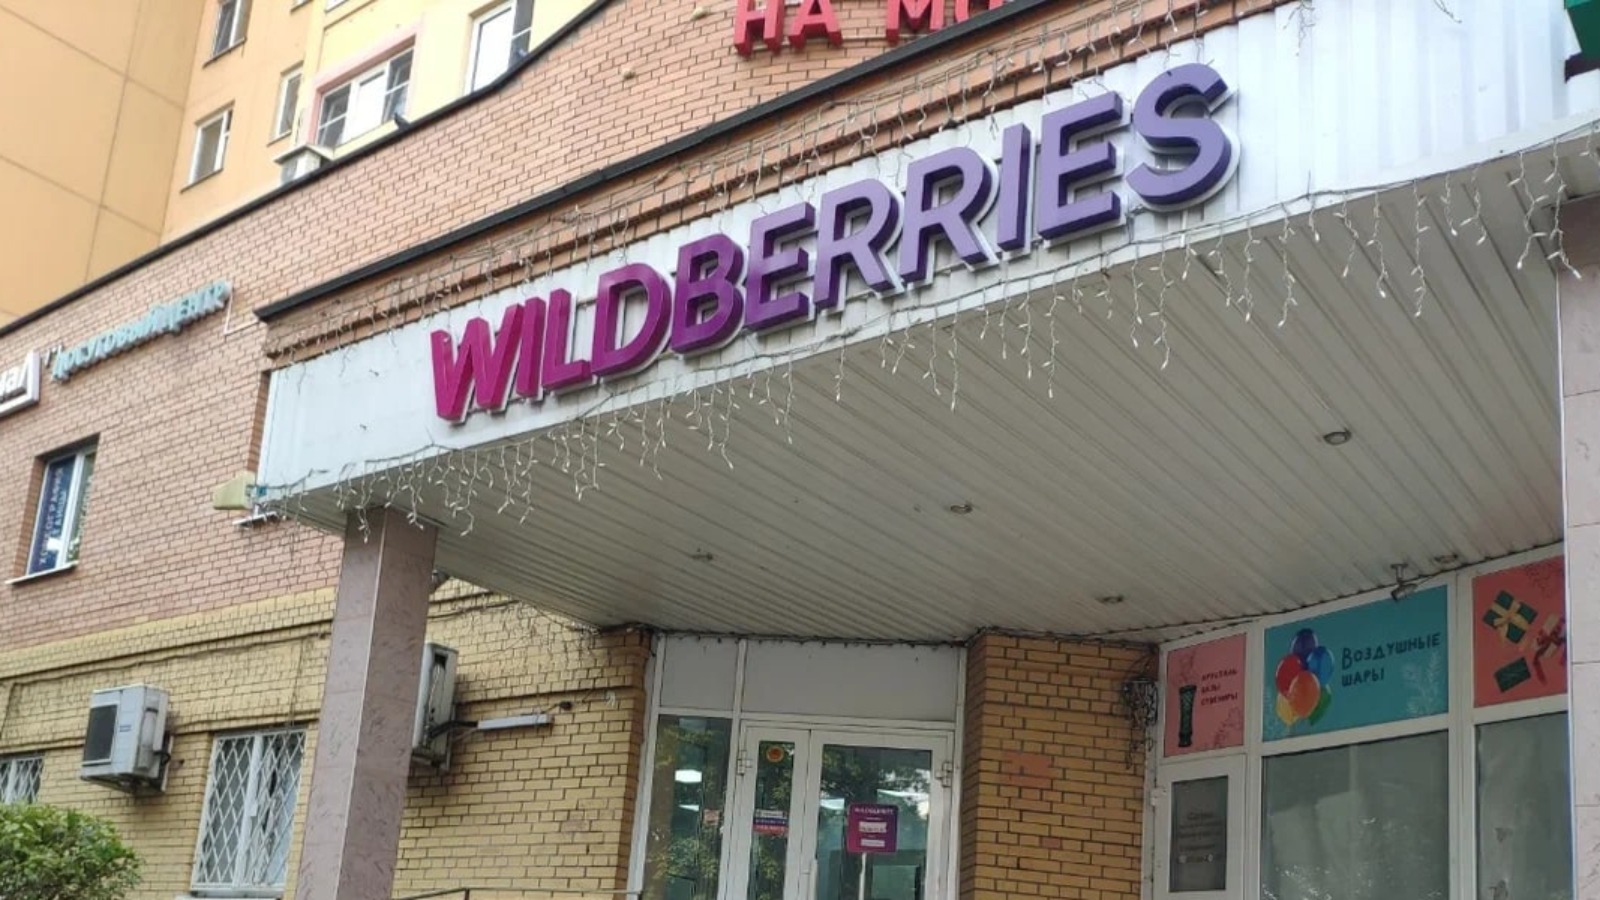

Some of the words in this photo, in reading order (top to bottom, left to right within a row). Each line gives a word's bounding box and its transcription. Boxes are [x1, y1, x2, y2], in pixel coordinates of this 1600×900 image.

[734, 0, 843, 53] НА
[430, 62, 1236, 424] WILDBERRIES
[1341, 667, 1385, 687] ШАРЫ
